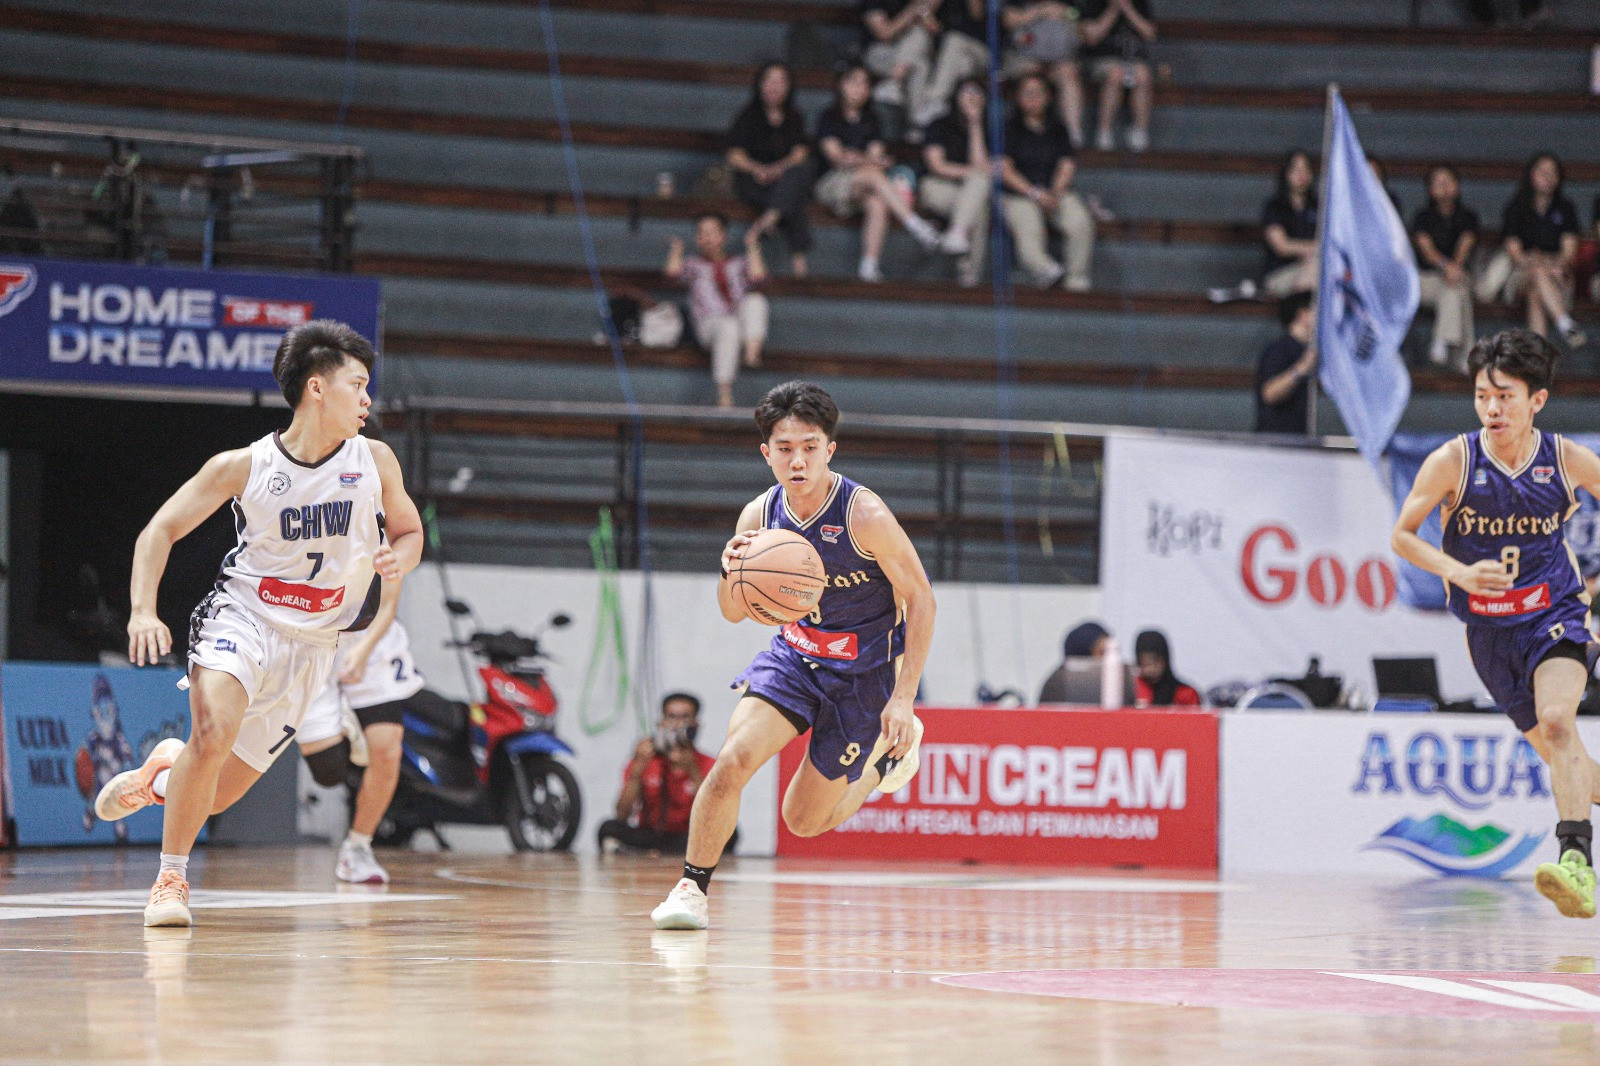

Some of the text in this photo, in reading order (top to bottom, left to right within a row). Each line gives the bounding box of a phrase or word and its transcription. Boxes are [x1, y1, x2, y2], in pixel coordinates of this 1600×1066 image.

[50, 282, 216, 328] HOME
[49, 325, 283, 373] DREAME
[280, 500, 353, 542] CHW
[306, 552, 324, 581] 7
[1241, 524, 1397, 609] Goo
[1501, 546, 1521, 581] 8
[261, 589, 280, 604] One
[784, 630, 798, 645] One
[268, 724, 297, 755] 7
[839, 742, 861, 766] 9
[986, 745, 1188, 811] CREAM
[1352, 732, 1551, 810] AQUA
[976, 811, 1025, 836] DAN
